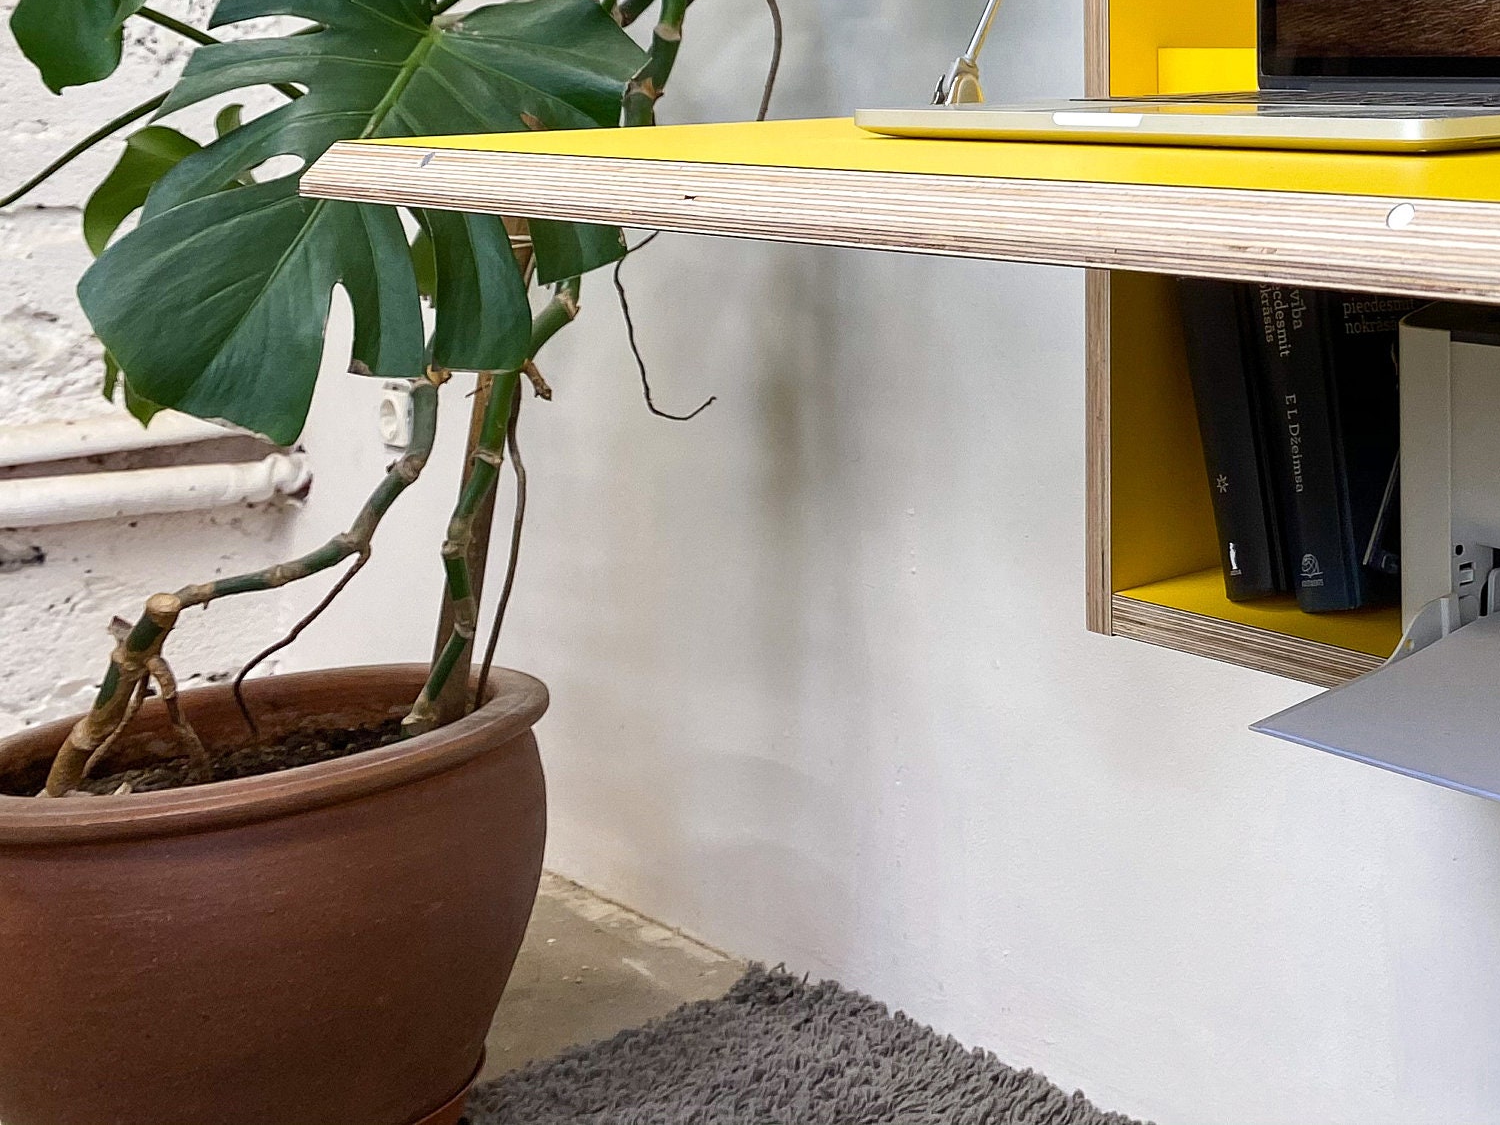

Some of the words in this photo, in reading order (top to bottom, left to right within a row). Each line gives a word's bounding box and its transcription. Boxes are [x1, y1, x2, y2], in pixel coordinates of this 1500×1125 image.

[1285, 393, 1297, 406] E
[1287, 408, 1298, 420] L
[1288, 423, 1304, 493] Džeimsa
